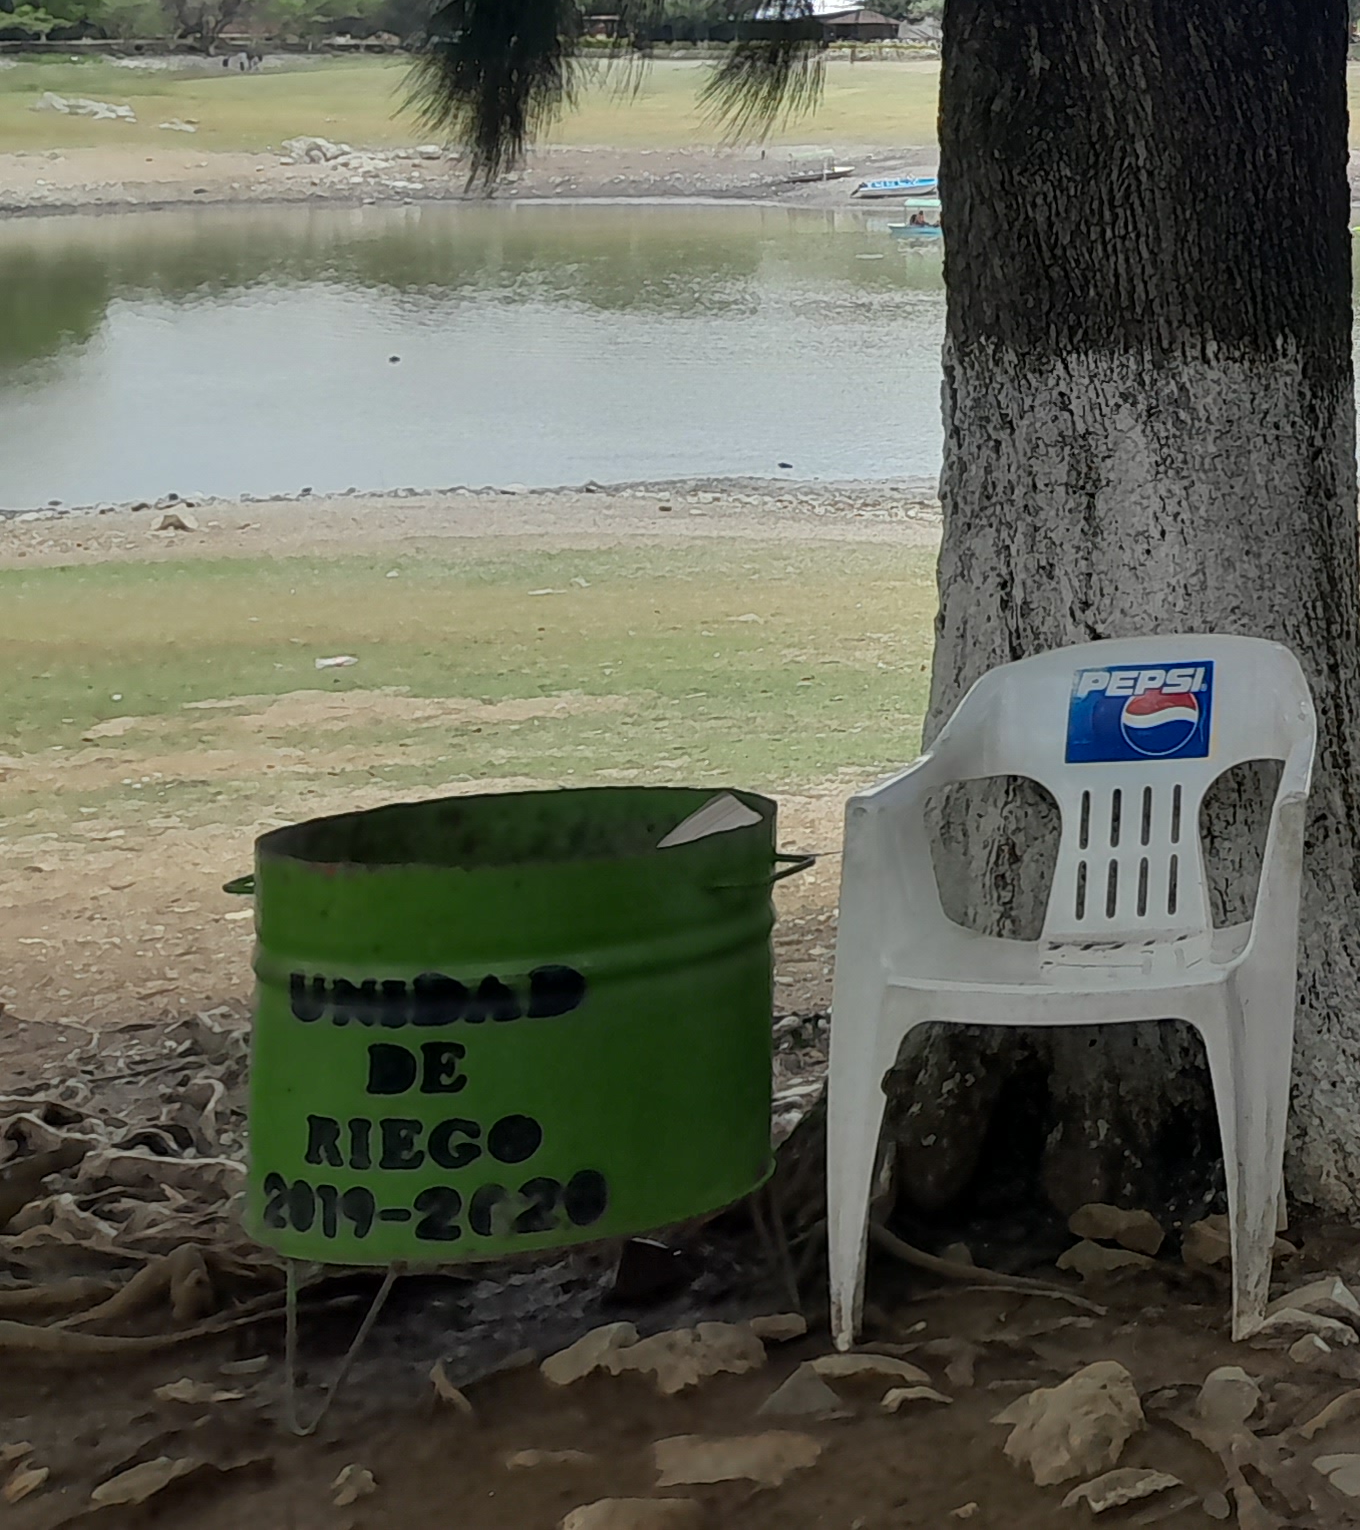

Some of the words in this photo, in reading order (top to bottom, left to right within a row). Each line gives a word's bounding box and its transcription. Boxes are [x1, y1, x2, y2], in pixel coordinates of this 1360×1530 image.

[1077, 667, 1206, 697] PEPSI
[290, 964, 586, 1028] UNIDAD
[367, 1042, 468, 1096] DE
[306, 1114, 543, 1170] RIEGO
[263, 1169, 608, 1242] 2019-2020
